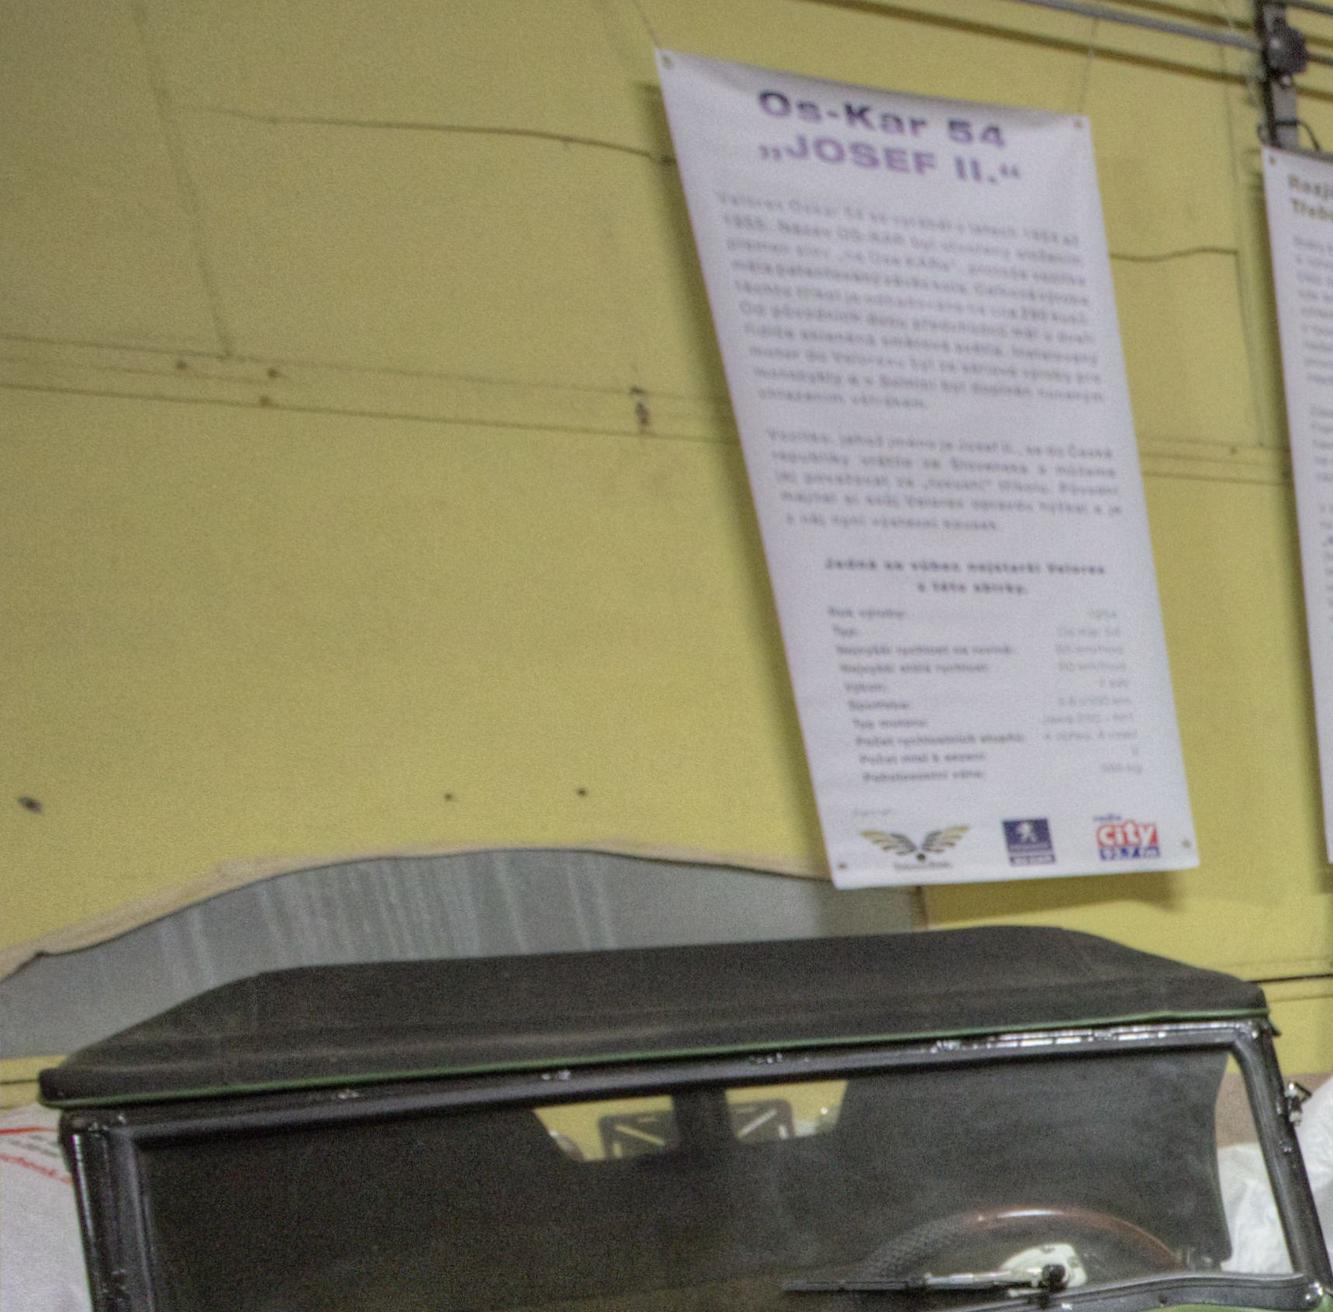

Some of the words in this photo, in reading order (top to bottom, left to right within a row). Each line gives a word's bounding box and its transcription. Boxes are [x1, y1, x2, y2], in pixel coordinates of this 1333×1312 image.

[758, 90, 928, 137] Os-Kar
[947, 117, 1005, 148] 54
[758, 134, 936, 176] „JOSEF
